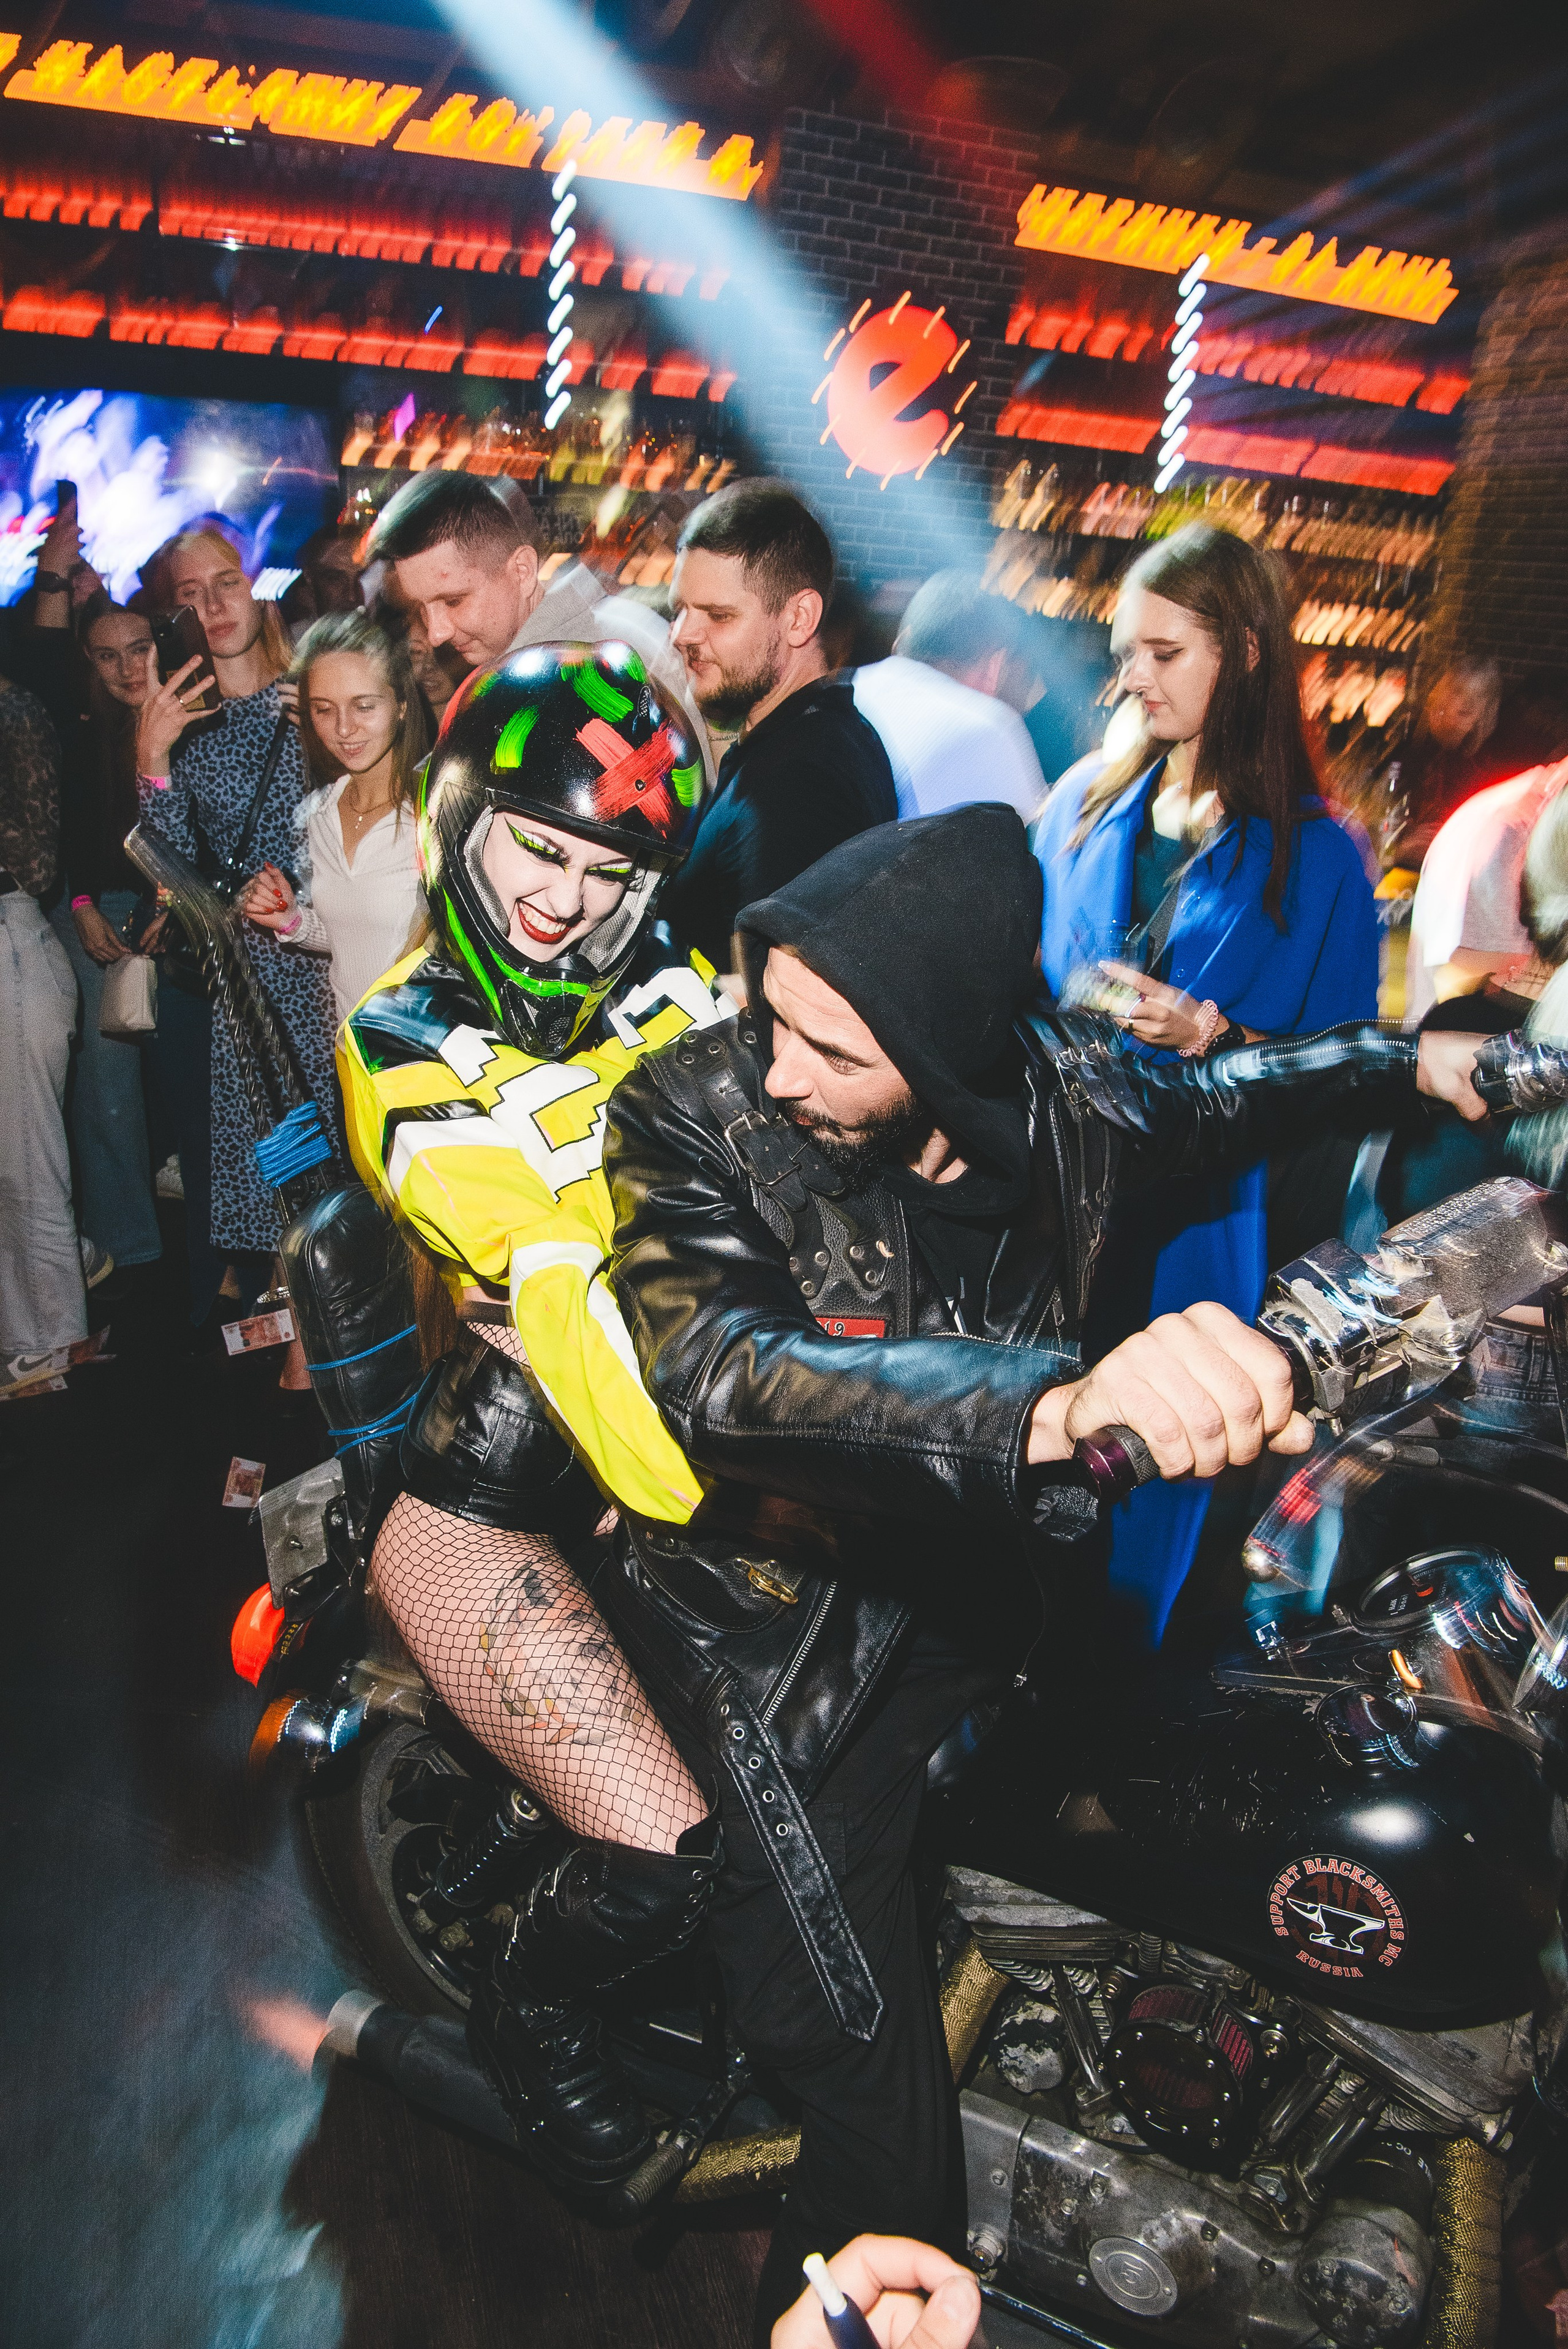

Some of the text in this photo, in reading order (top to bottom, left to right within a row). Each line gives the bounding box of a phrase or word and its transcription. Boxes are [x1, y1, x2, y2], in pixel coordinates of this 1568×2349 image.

[816, 1319, 845, 1337] 19
[1270, 1864, 1302, 1936] SUPPORT
[1302, 1858, 1404, 1940] BLACKSMITHS
[1378, 1942, 1402, 1967] MC
[1295, 1950, 1364, 1977] RUSSIA
